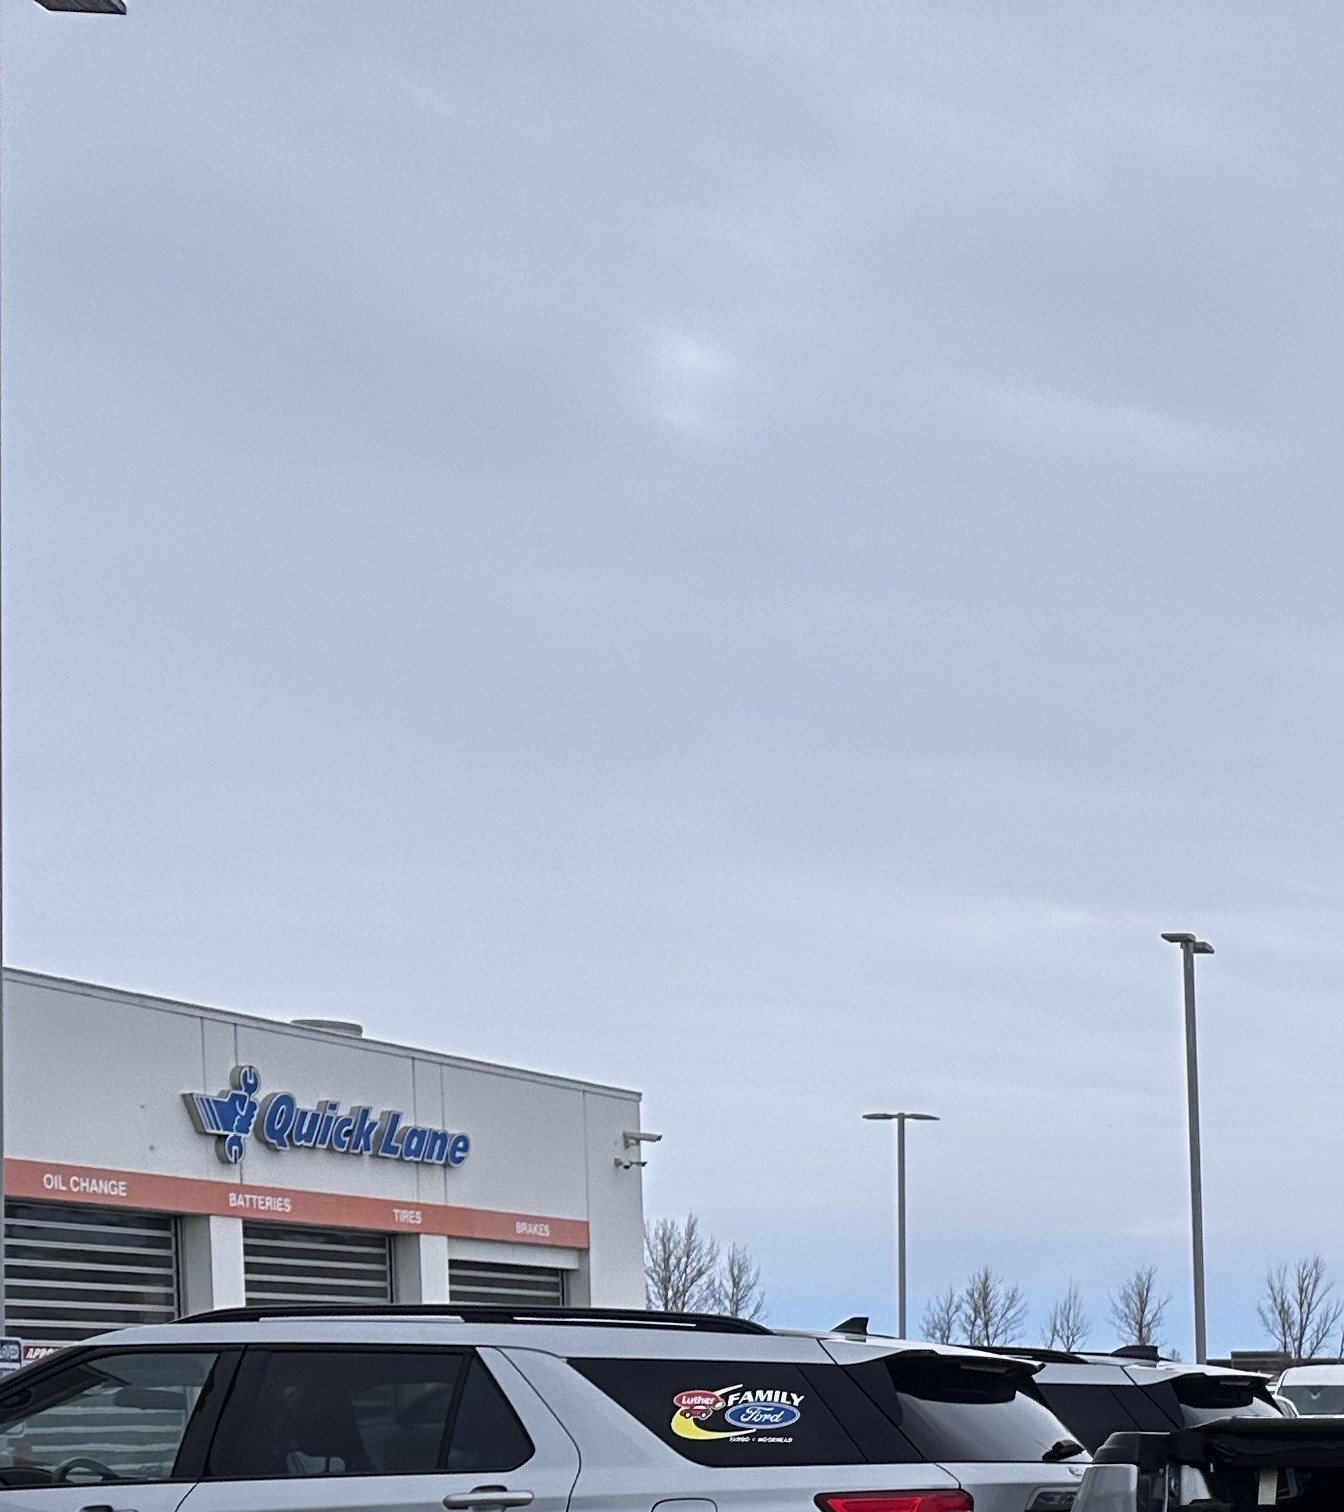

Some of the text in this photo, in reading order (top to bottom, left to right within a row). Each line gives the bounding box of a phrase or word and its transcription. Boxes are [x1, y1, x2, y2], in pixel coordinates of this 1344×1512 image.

[262, 1091, 471, 1167] Quick Lane
[43, 1173, 127, 1196] OIL CHANGE
[228, 1192, 292, 1212] BATTERIES
[393, 1208, 422, 1225] TIRES
[515, 1220, 550, 1237] BRAKES
[681, 1395, 716, 1405] Luther
[727, 1389, 805, 1407] FAMILY
[740, 1406, 785, 1423] Ford
